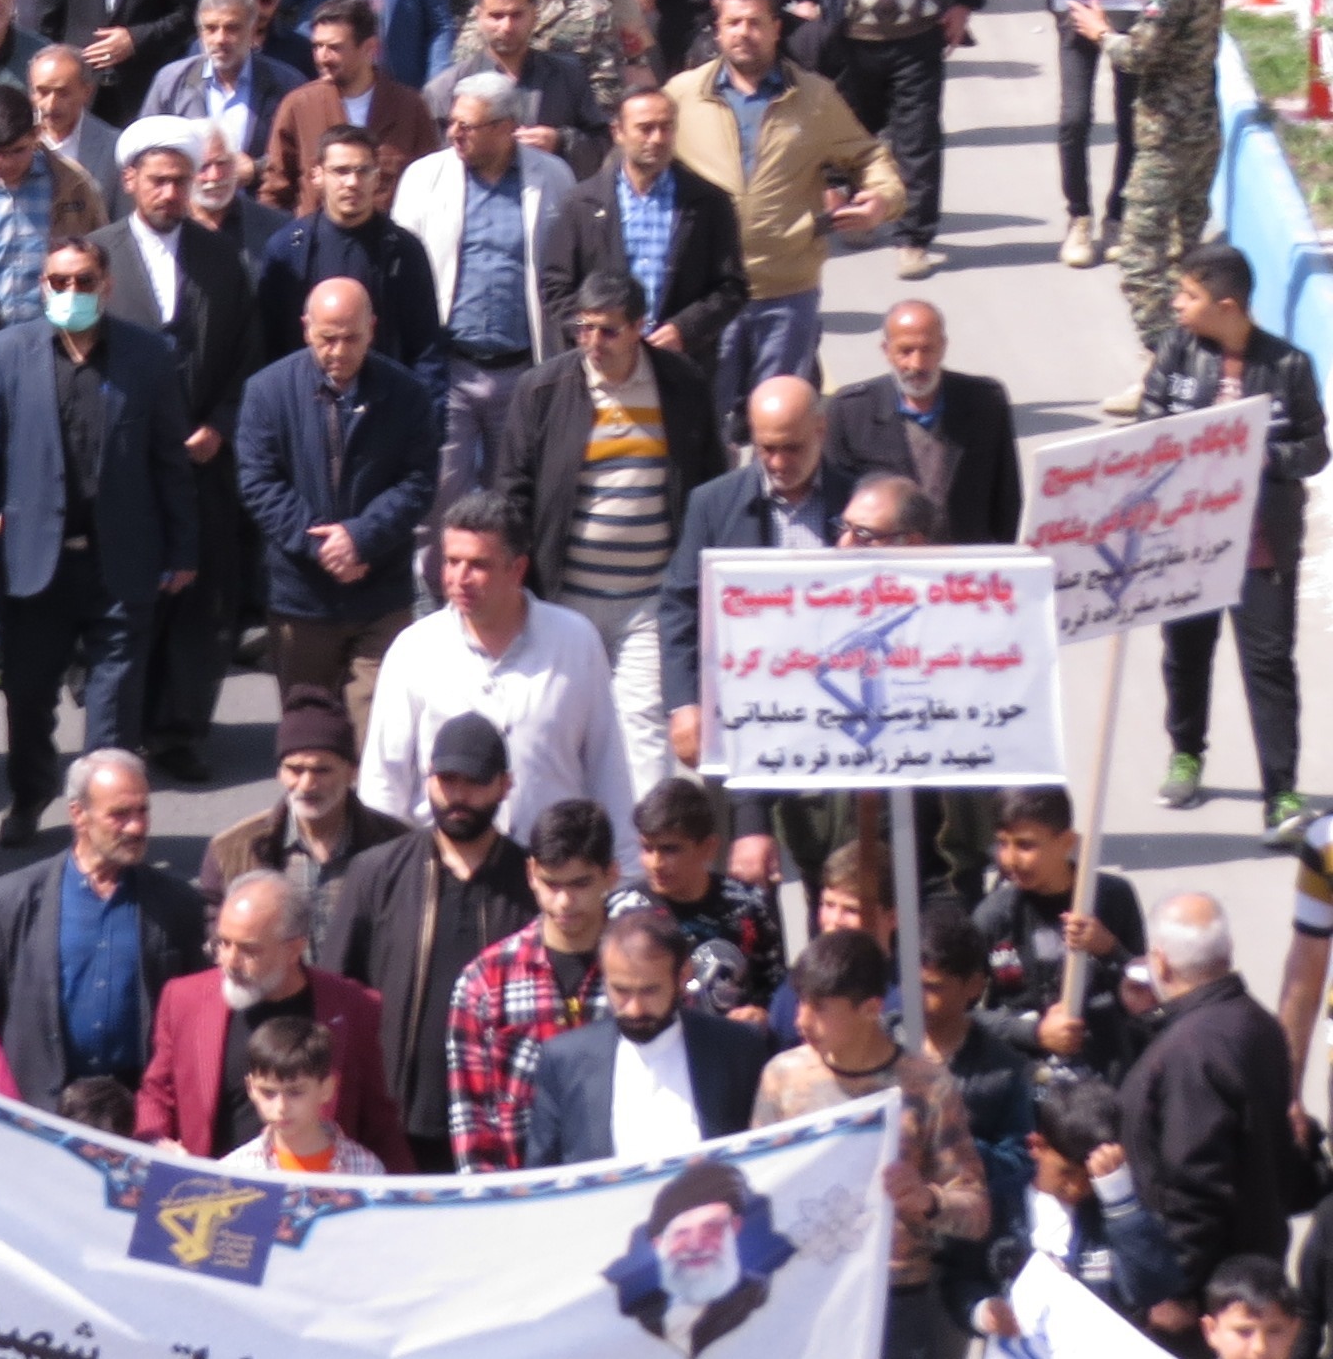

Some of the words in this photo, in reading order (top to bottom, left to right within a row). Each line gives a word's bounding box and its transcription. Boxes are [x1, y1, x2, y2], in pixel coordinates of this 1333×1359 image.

[1188, 417, 1249, 454] پایگاه
[1103, 433, 1183, 477] مقاومت
[1041, 458, 1098, 496] بسیج
[1200, 479, 1243, 511] شهید
[1201, 540, 1233, 565] حوزه
[721, 584, 794, 617] بسیج
[804, 574, 918, 617] مقاومت
[927, 571, 1017, 615] پایگاه
[1165, 580, 1202, 607] شهید
[969, 643, 1023, 672] شهید
[722, 701, 808, 732] عملیاتی
[816, 708, 874, 731] بسیج
[878, 698, 960, 733] مقاومت
[966, 703, 1028, 727] حوزه
[758, 748, 784, 774] تپه
[792, 748, 830, 775] قره
[941, 744, 996, 772] شهید
